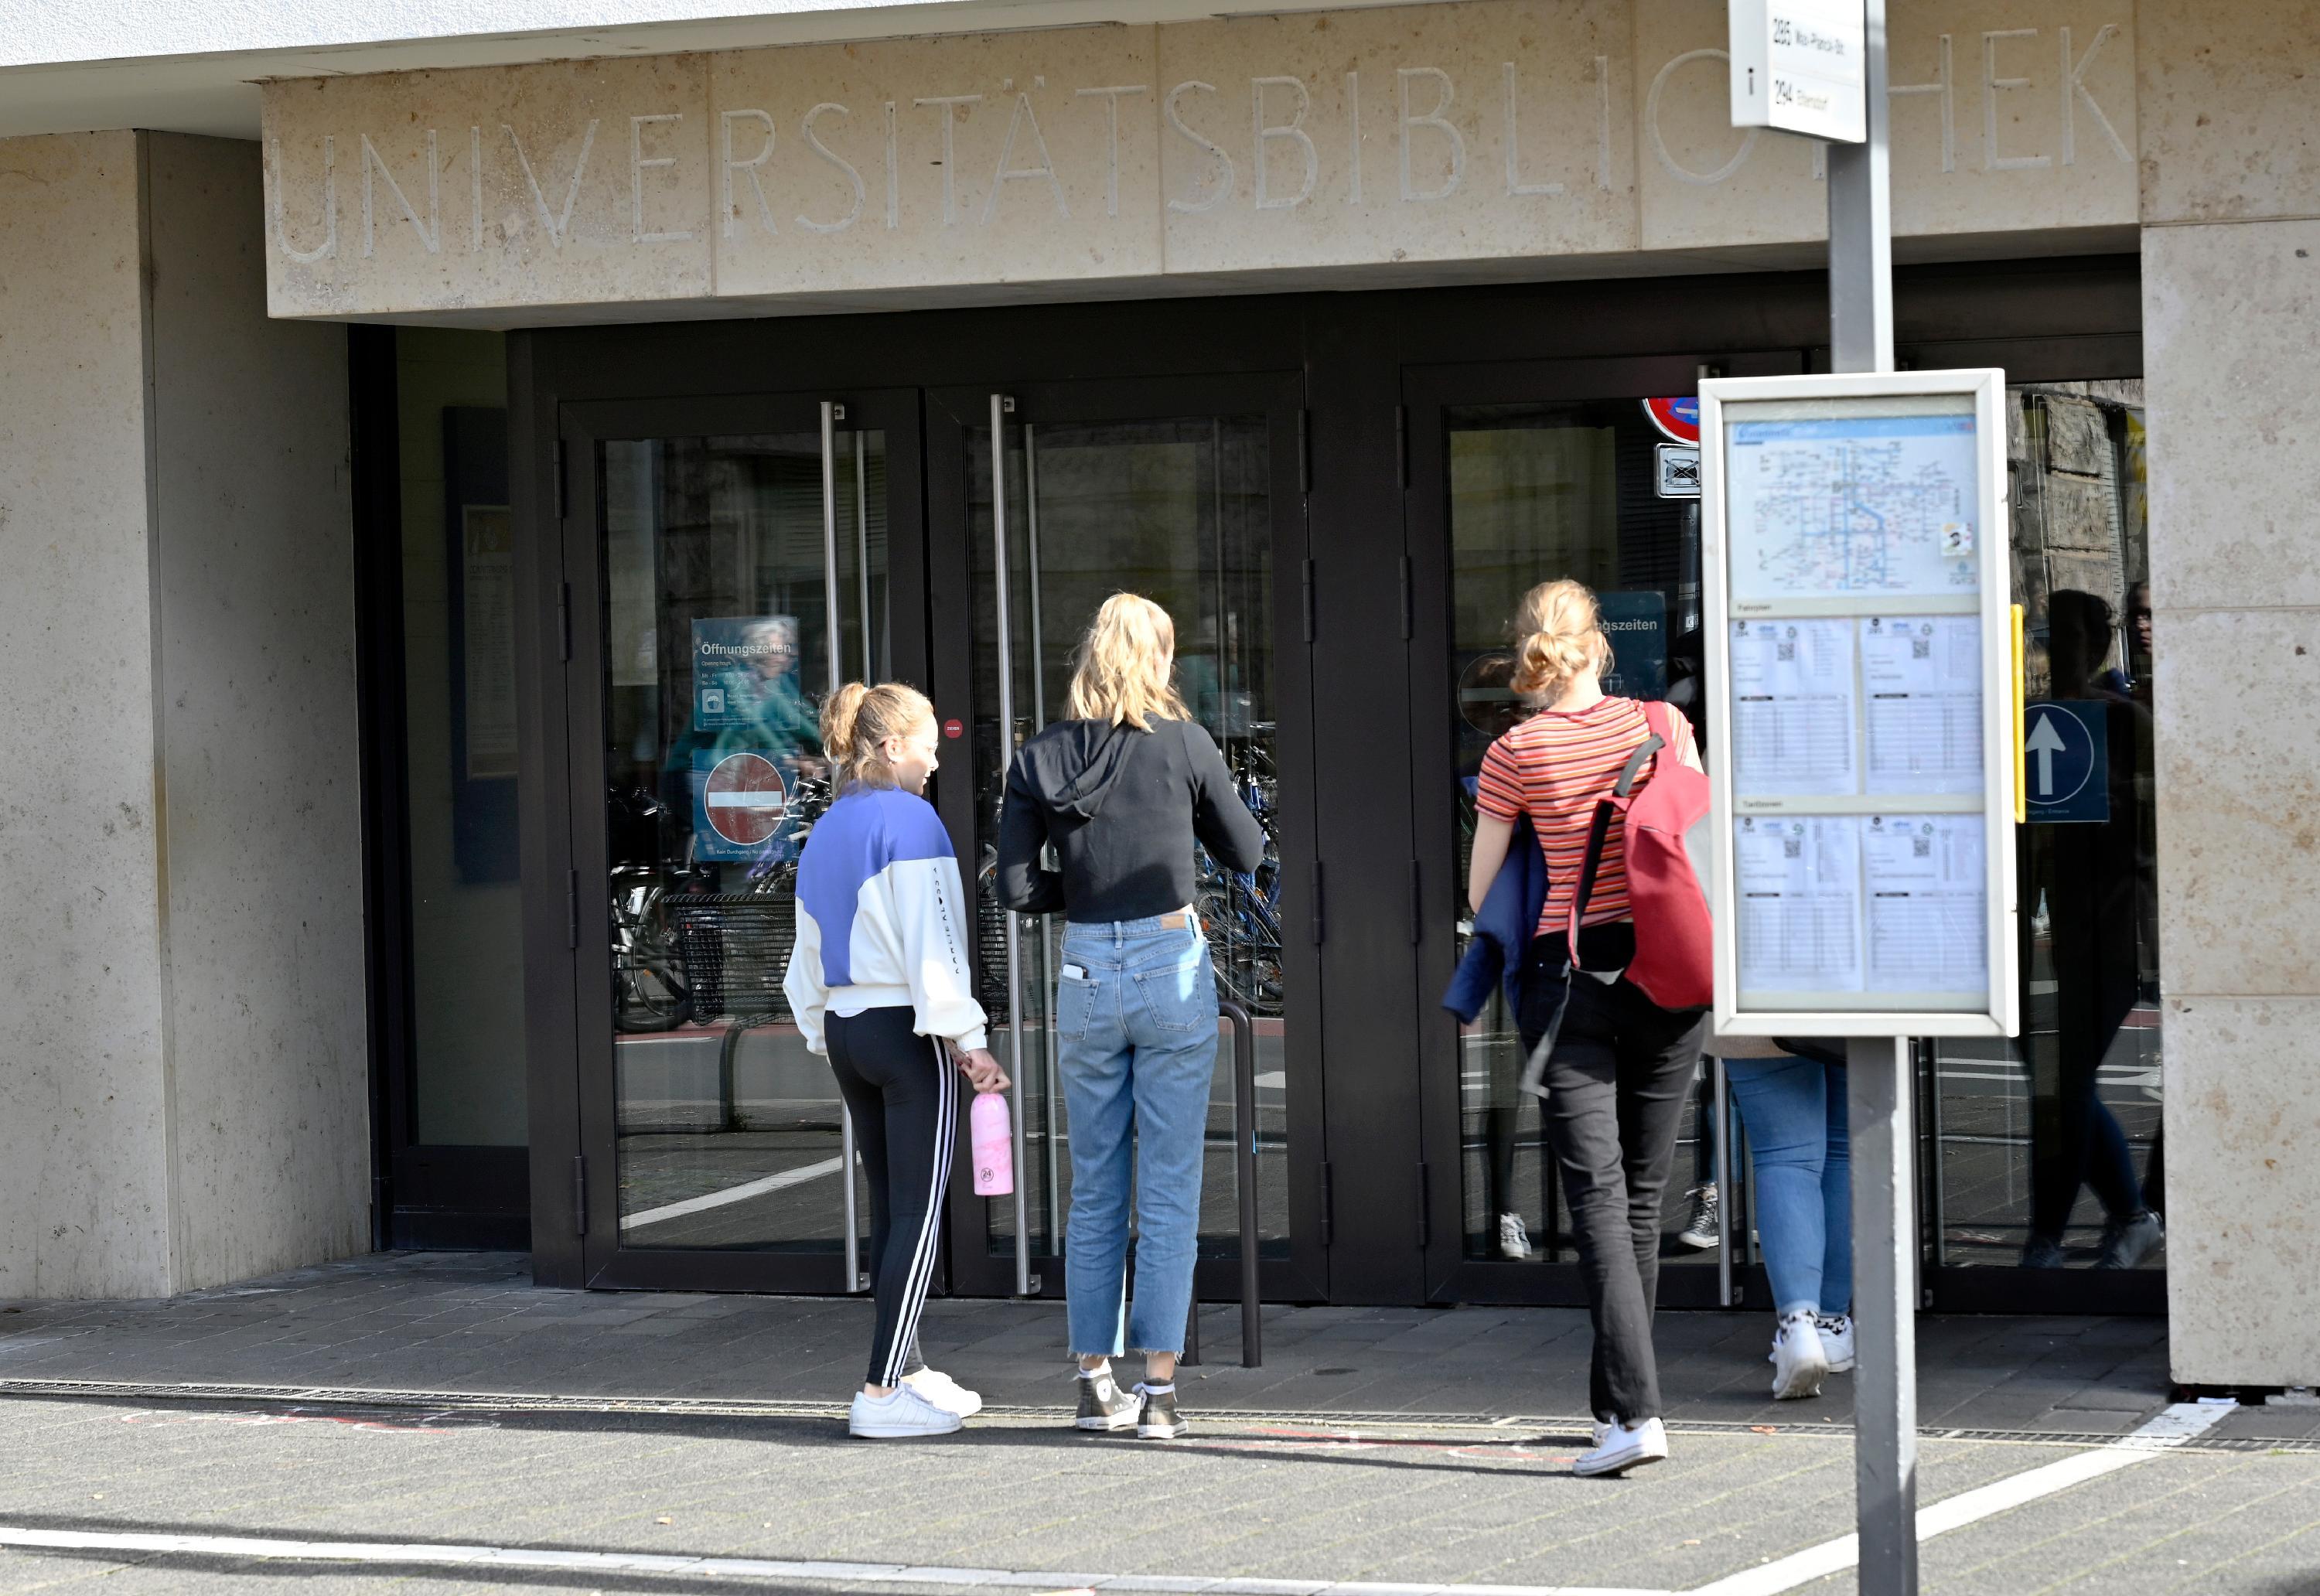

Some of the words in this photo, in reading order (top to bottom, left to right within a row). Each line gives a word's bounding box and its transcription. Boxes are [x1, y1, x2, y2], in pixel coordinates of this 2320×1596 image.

[271, 22, 2133, 264] UNIVERSITÄTSBIBLIOHEK
[1596, 619, 1657, 633] ngszeiten
[701, 641, 791, 656] Öffnungszeiten
